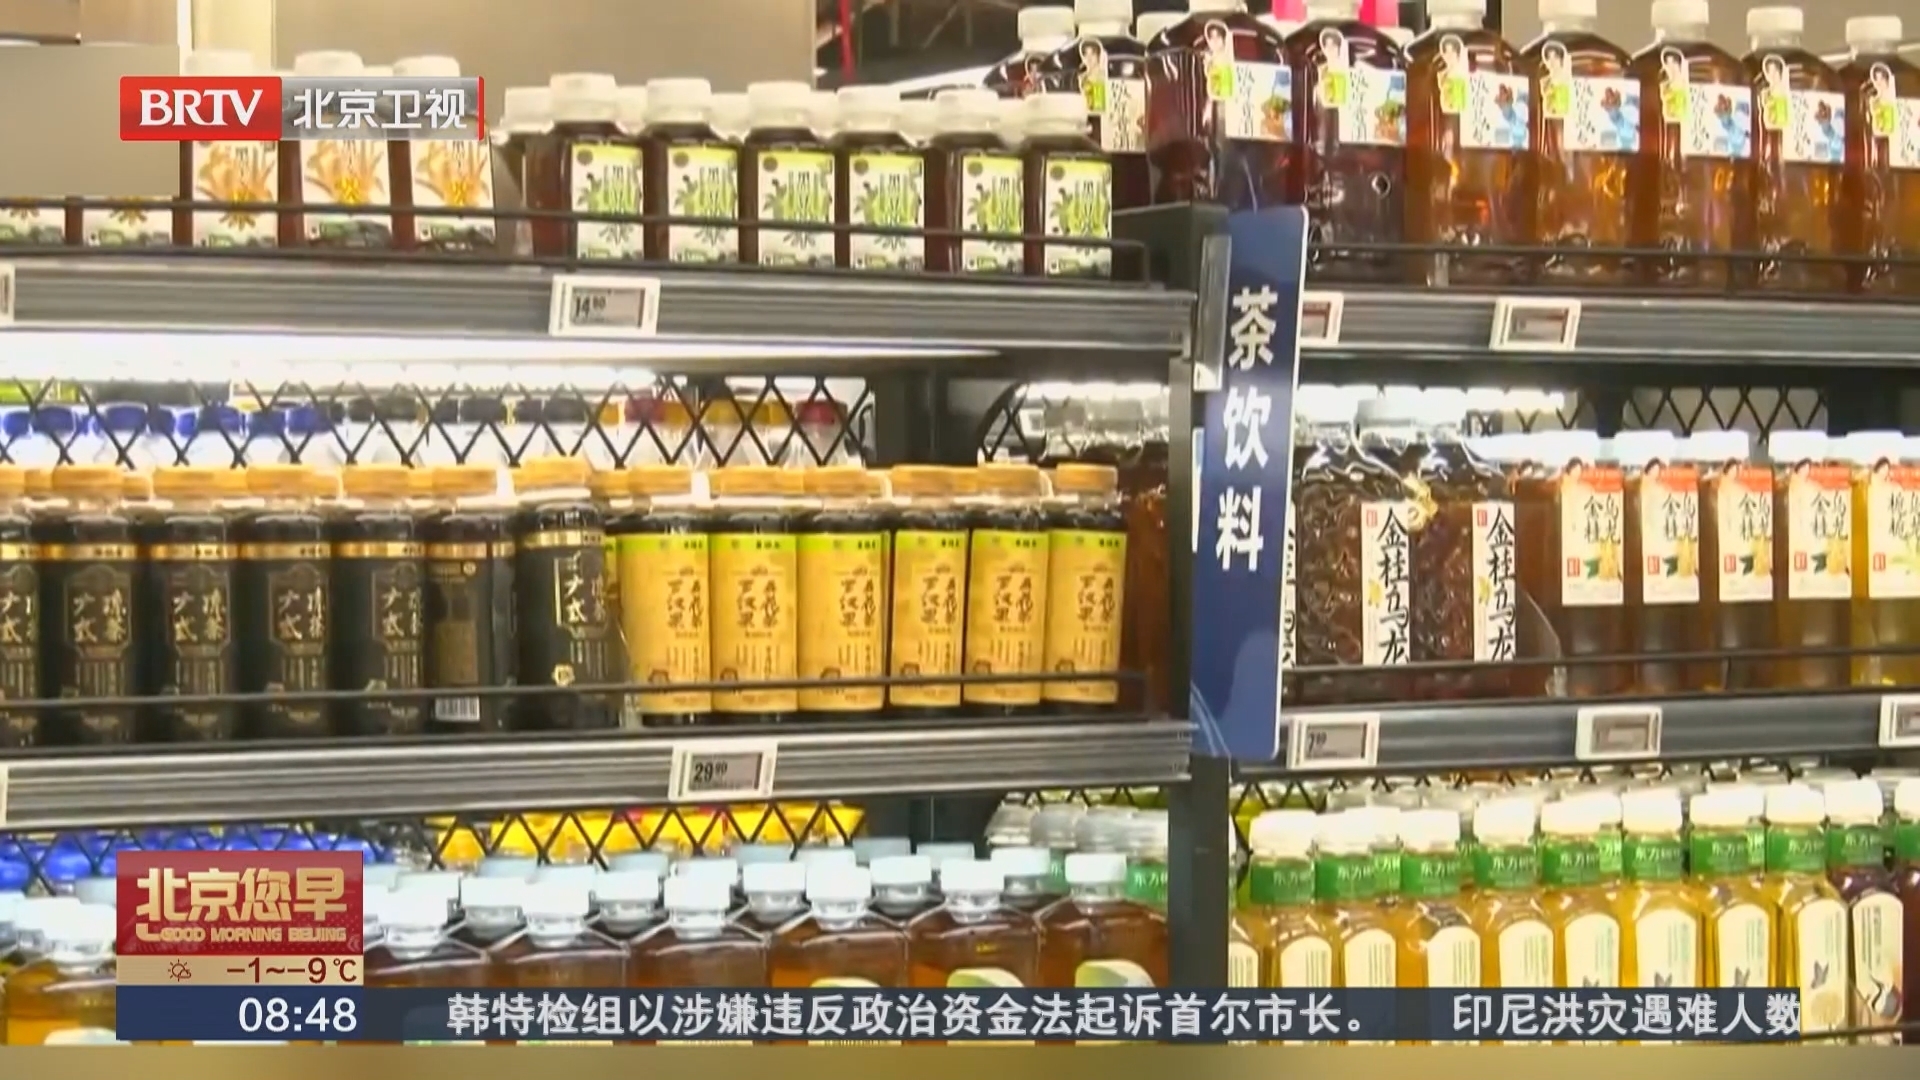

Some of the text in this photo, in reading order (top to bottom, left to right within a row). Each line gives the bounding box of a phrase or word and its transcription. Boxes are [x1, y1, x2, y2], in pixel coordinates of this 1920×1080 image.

[1216, 285, 1278, 571] 茶饮料
[1377, 506, 1410, 664] 金桂乌龙
